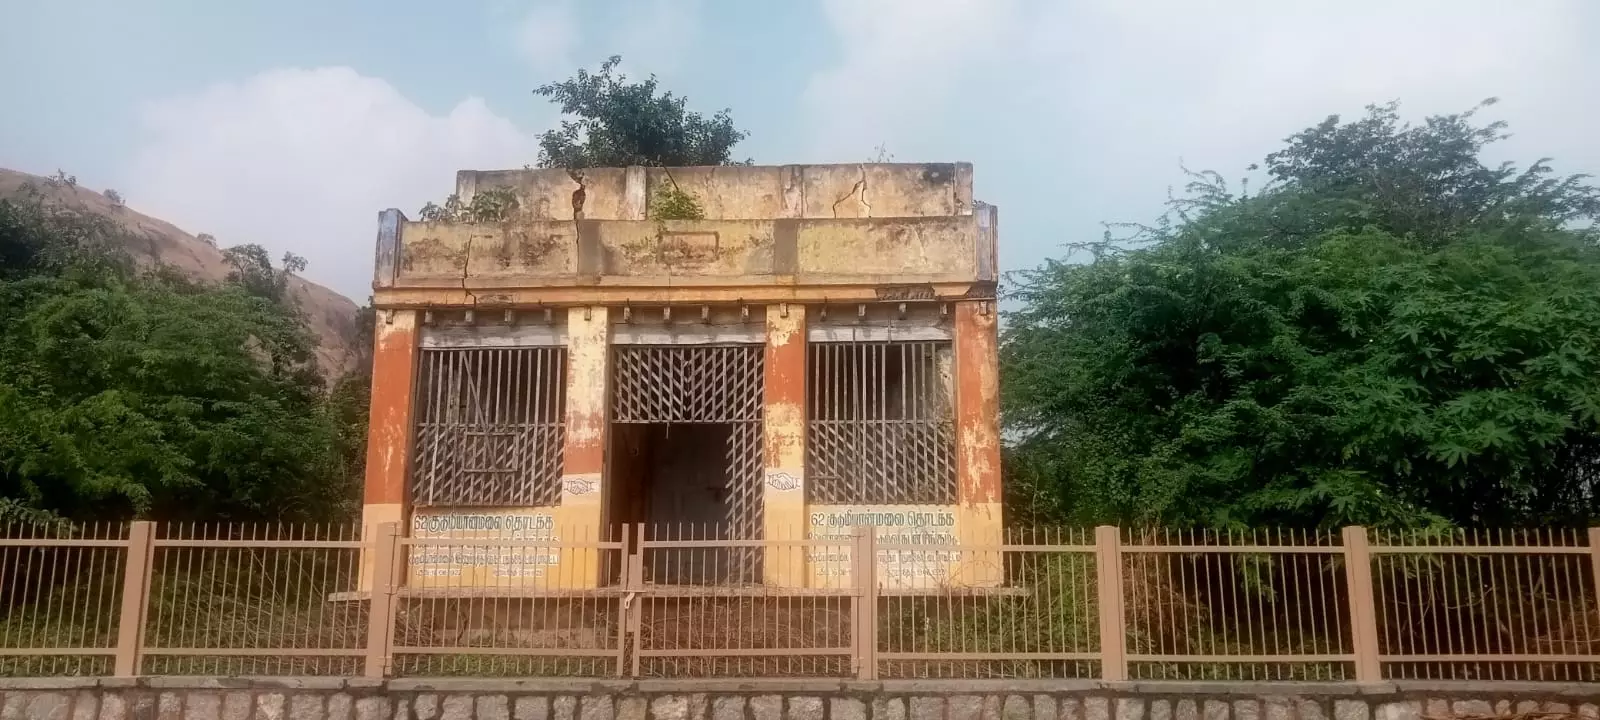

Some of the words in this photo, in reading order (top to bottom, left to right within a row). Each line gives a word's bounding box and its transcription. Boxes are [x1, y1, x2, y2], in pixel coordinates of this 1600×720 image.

[414, 514, 427, 530] 62
[505, 513, 554, 534] தொடக்க
[811, 513, 825, 527] 62
[907, 509, 955, 529] தொடக்க
